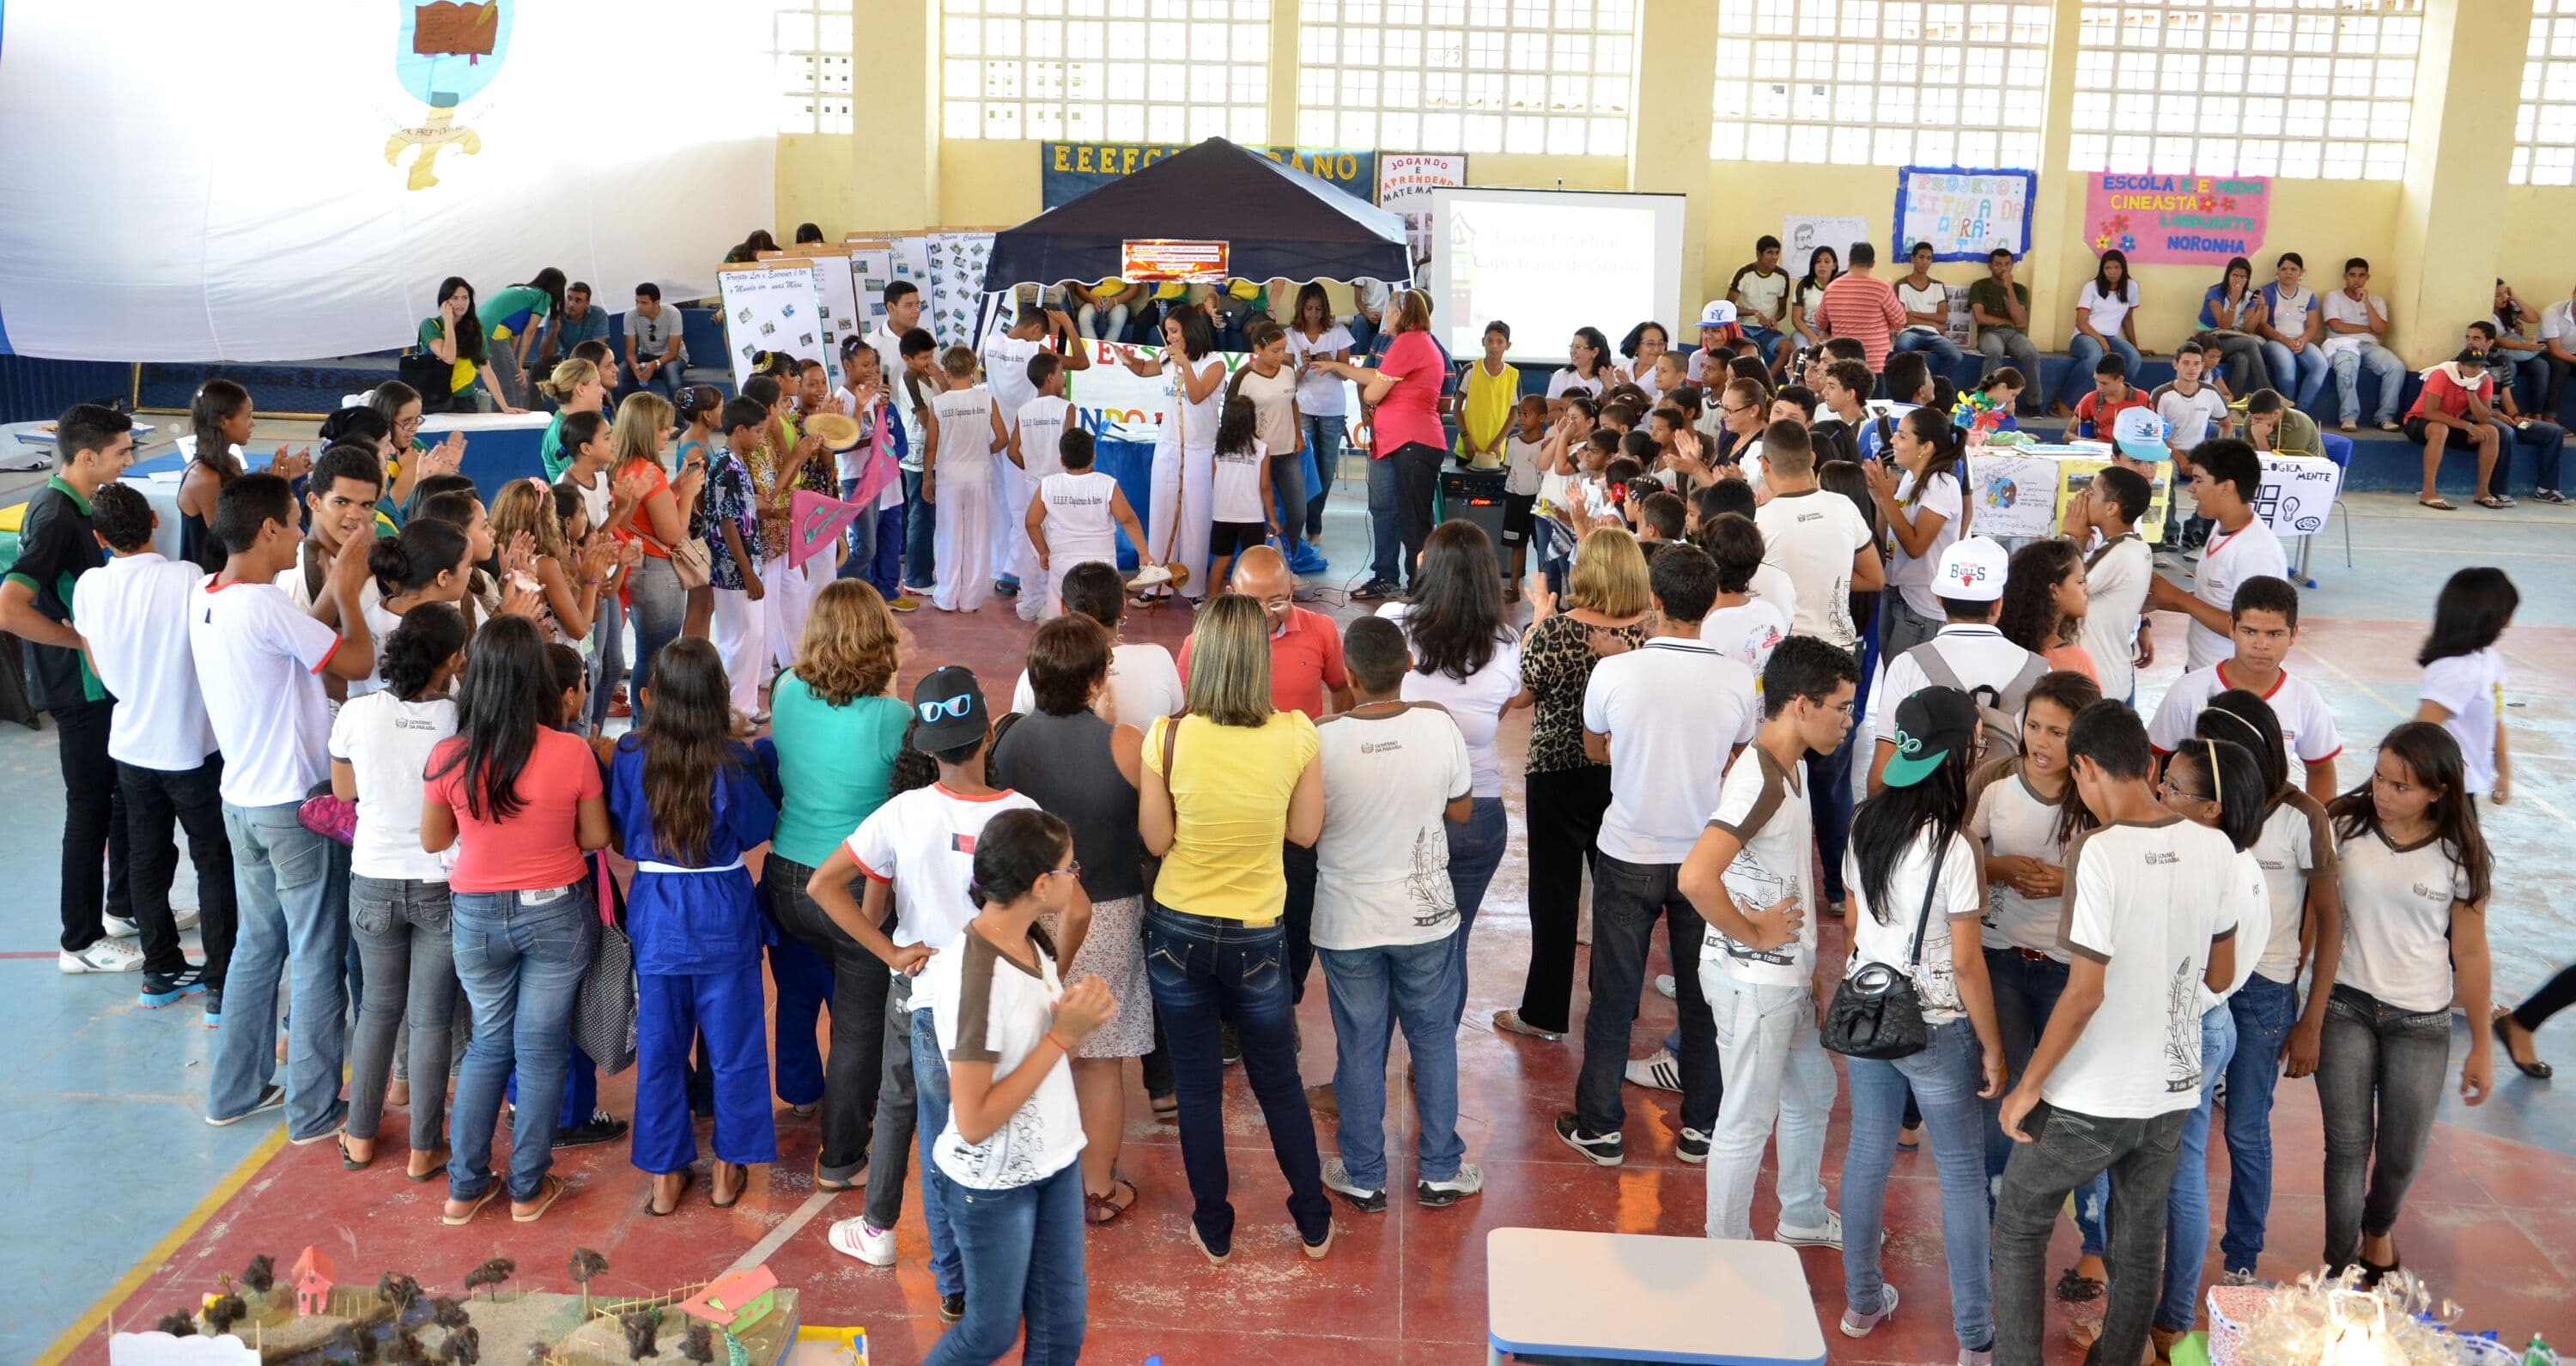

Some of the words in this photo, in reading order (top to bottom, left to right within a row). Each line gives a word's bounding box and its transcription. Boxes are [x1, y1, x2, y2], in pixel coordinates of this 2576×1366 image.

[1392, 157, 1449, 170] JOGANDO
[1384, 175, 1458, 190] APRENDEND
[2103, 176, 2174, 191] ESCOLA
[2110, 194, 2198, 210] CINEASTA
[2166, 235, 2246, 253] NORONHA
[2296, 471, 2332, 482] MENTE
[1950, 563, 1985, 581] BULLS
[1764, 954, 1781, 963] 1585
